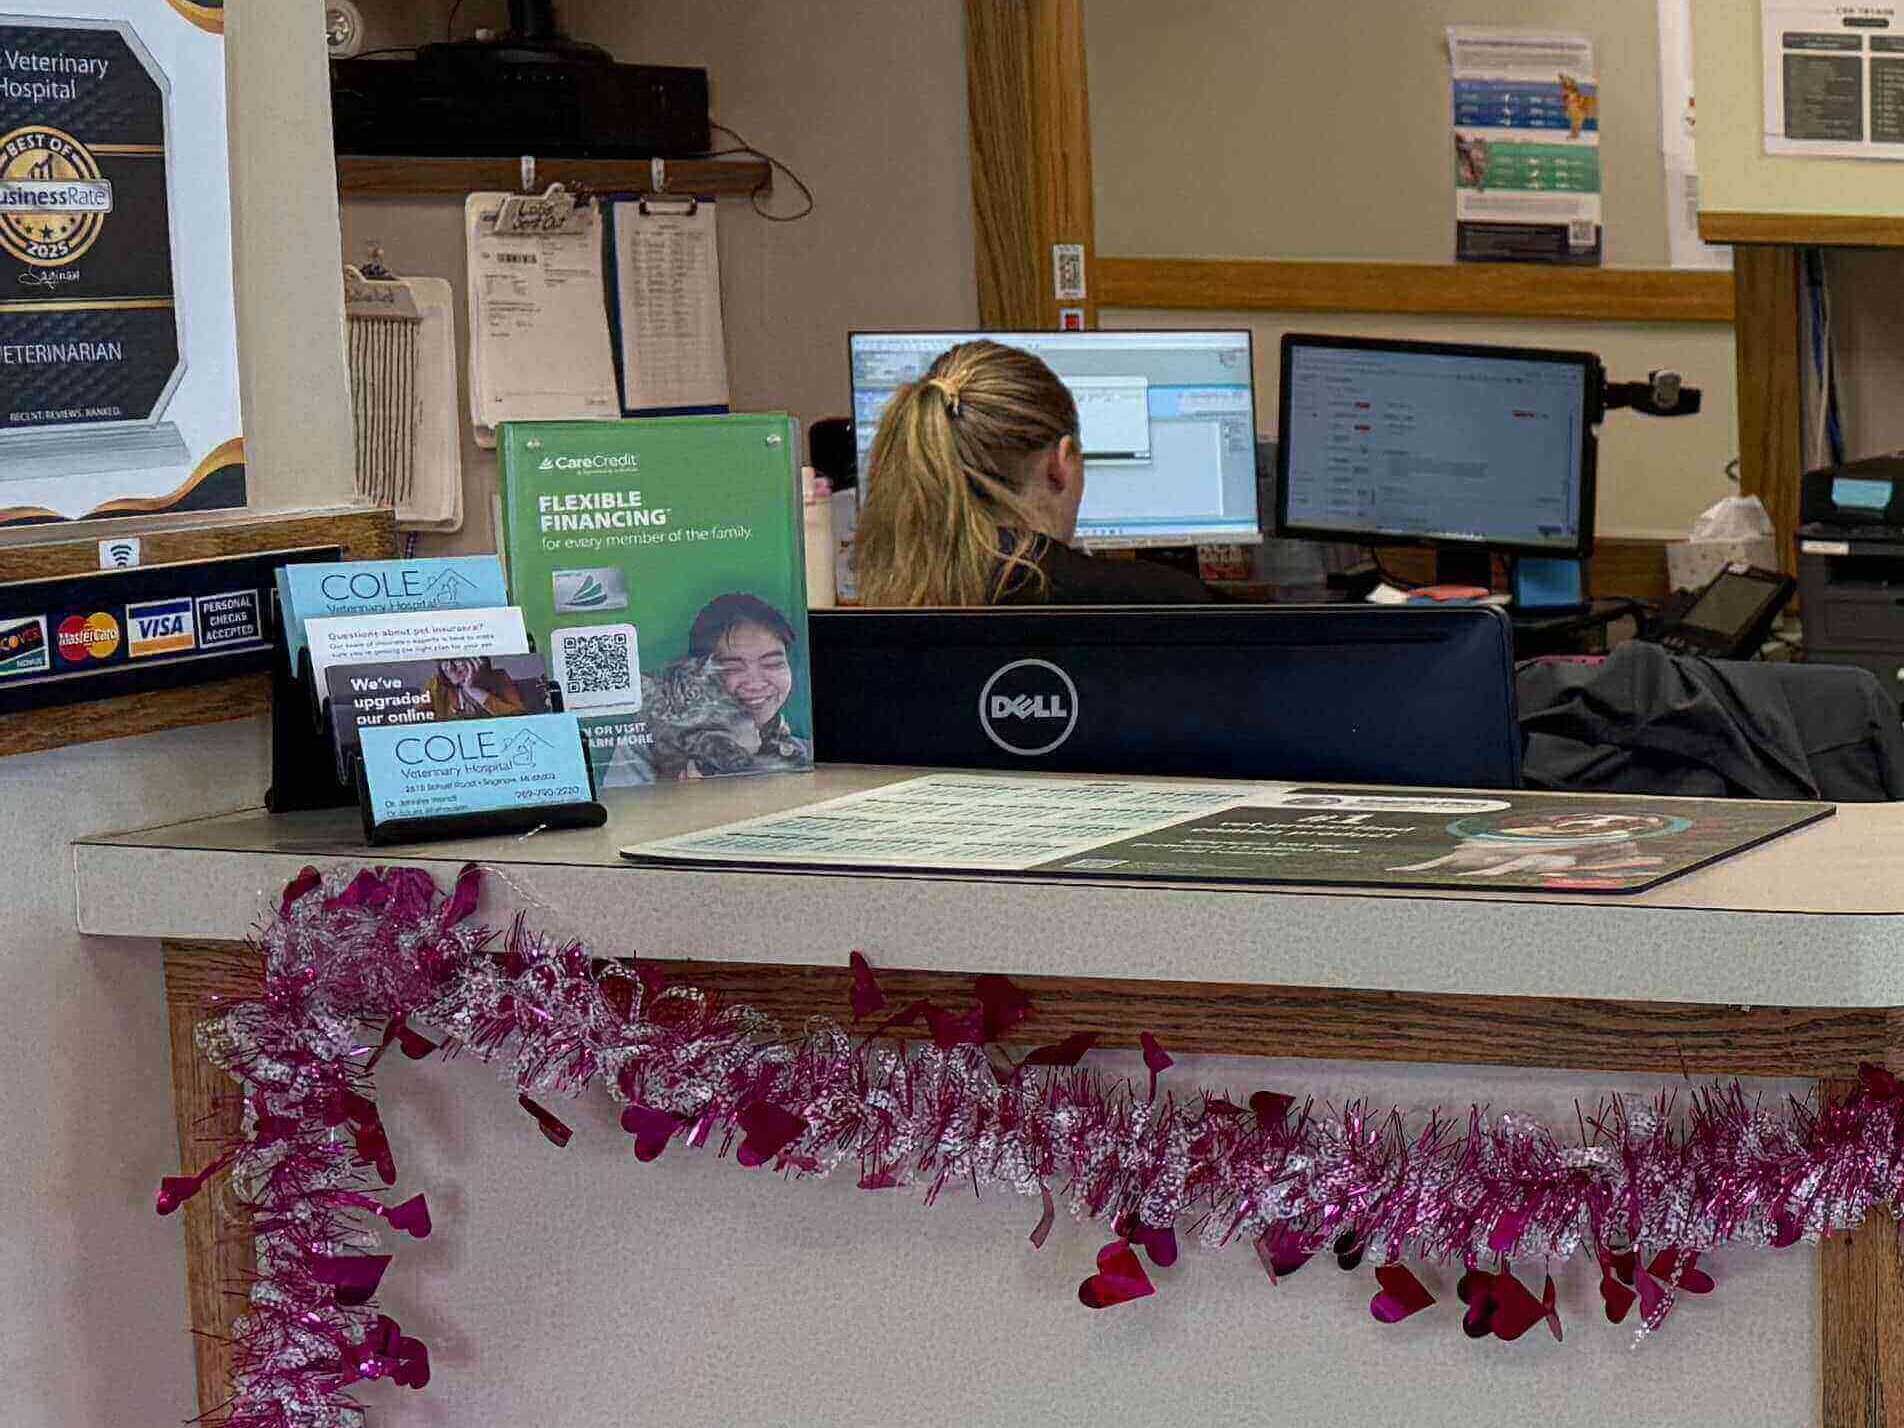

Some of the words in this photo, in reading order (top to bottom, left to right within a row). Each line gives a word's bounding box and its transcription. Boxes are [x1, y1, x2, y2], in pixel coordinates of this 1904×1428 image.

[5, 50, 109, 78] Veterinary
[6, 134, 45, 158] BEST
[50, 136, 71, 156] OF
[27, 241, 68, 257] 2025
[555, 453, 638, 470] CareCredit
[539, 490, 642, 512] FLEXIBLE
[542, 537, 561, 551] for
[565, 535, 603, 551] every
[606, 530, 665, 546] member
[668, 528, 684, 543] of
[686, 528, 709, 541] the
[320, 569, 423, 602] COLE
[203, 596, 253, 614] PERSONAL
[138, 616, 185, 639] VISA
[209, 611, 248, 626] CHECKS
[206, 623, 255, 642] ACCEPTED
[351, 677, 402, 692] We've
[354, 690, 431, 711] upgraded
[991, 694, 1068, 721] DELL
[356, 711, 384, 725] our
[388, 708, 434, 723] online
[395, 731, 499, 765] COLE
[401, 765, 461, 780] Veterinary
[465, 760, 514, 775] Hospital
